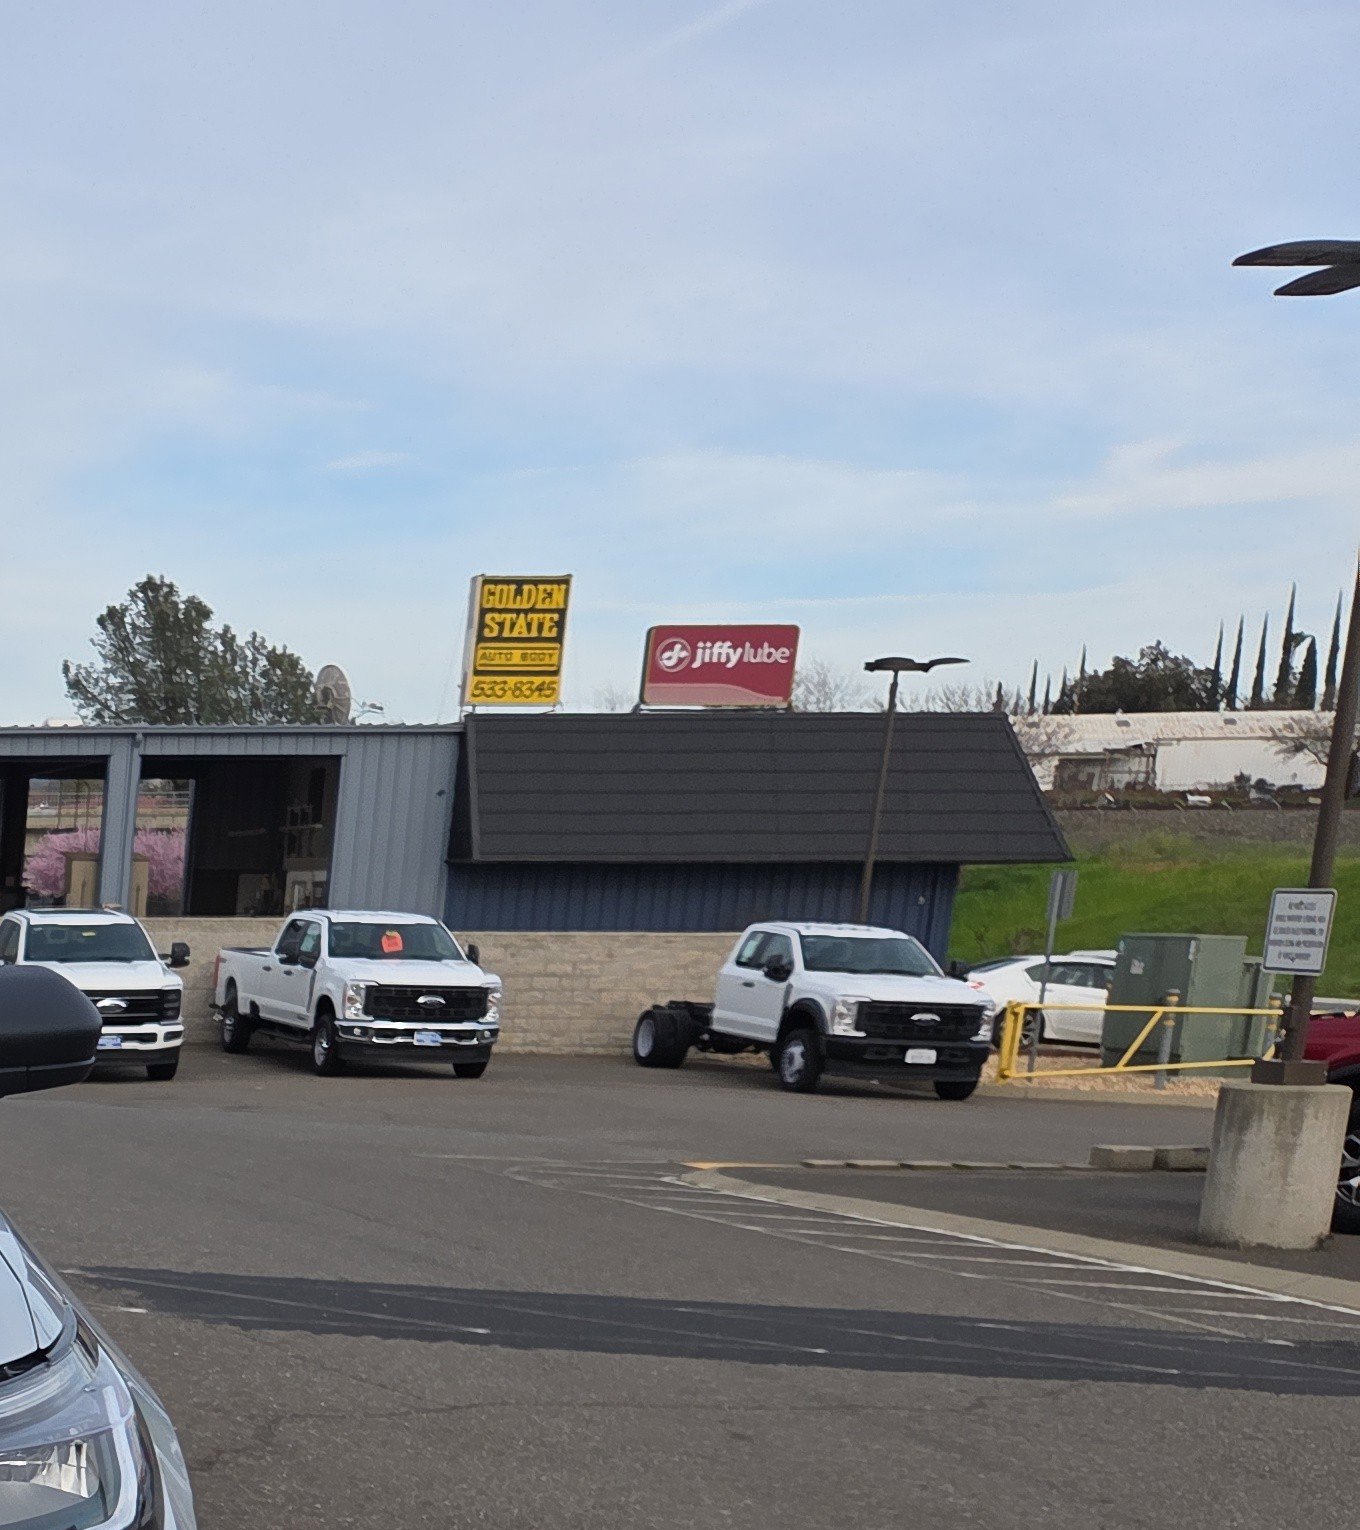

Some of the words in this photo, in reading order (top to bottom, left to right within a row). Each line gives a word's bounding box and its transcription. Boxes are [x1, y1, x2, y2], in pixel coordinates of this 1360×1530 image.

[482, 584, 567, 609] GOLDEN
[483, 613, 559, 638] STATE
[480, 652, 512, 661] AUTO
[471, 680, 557, 698] 533-8345
